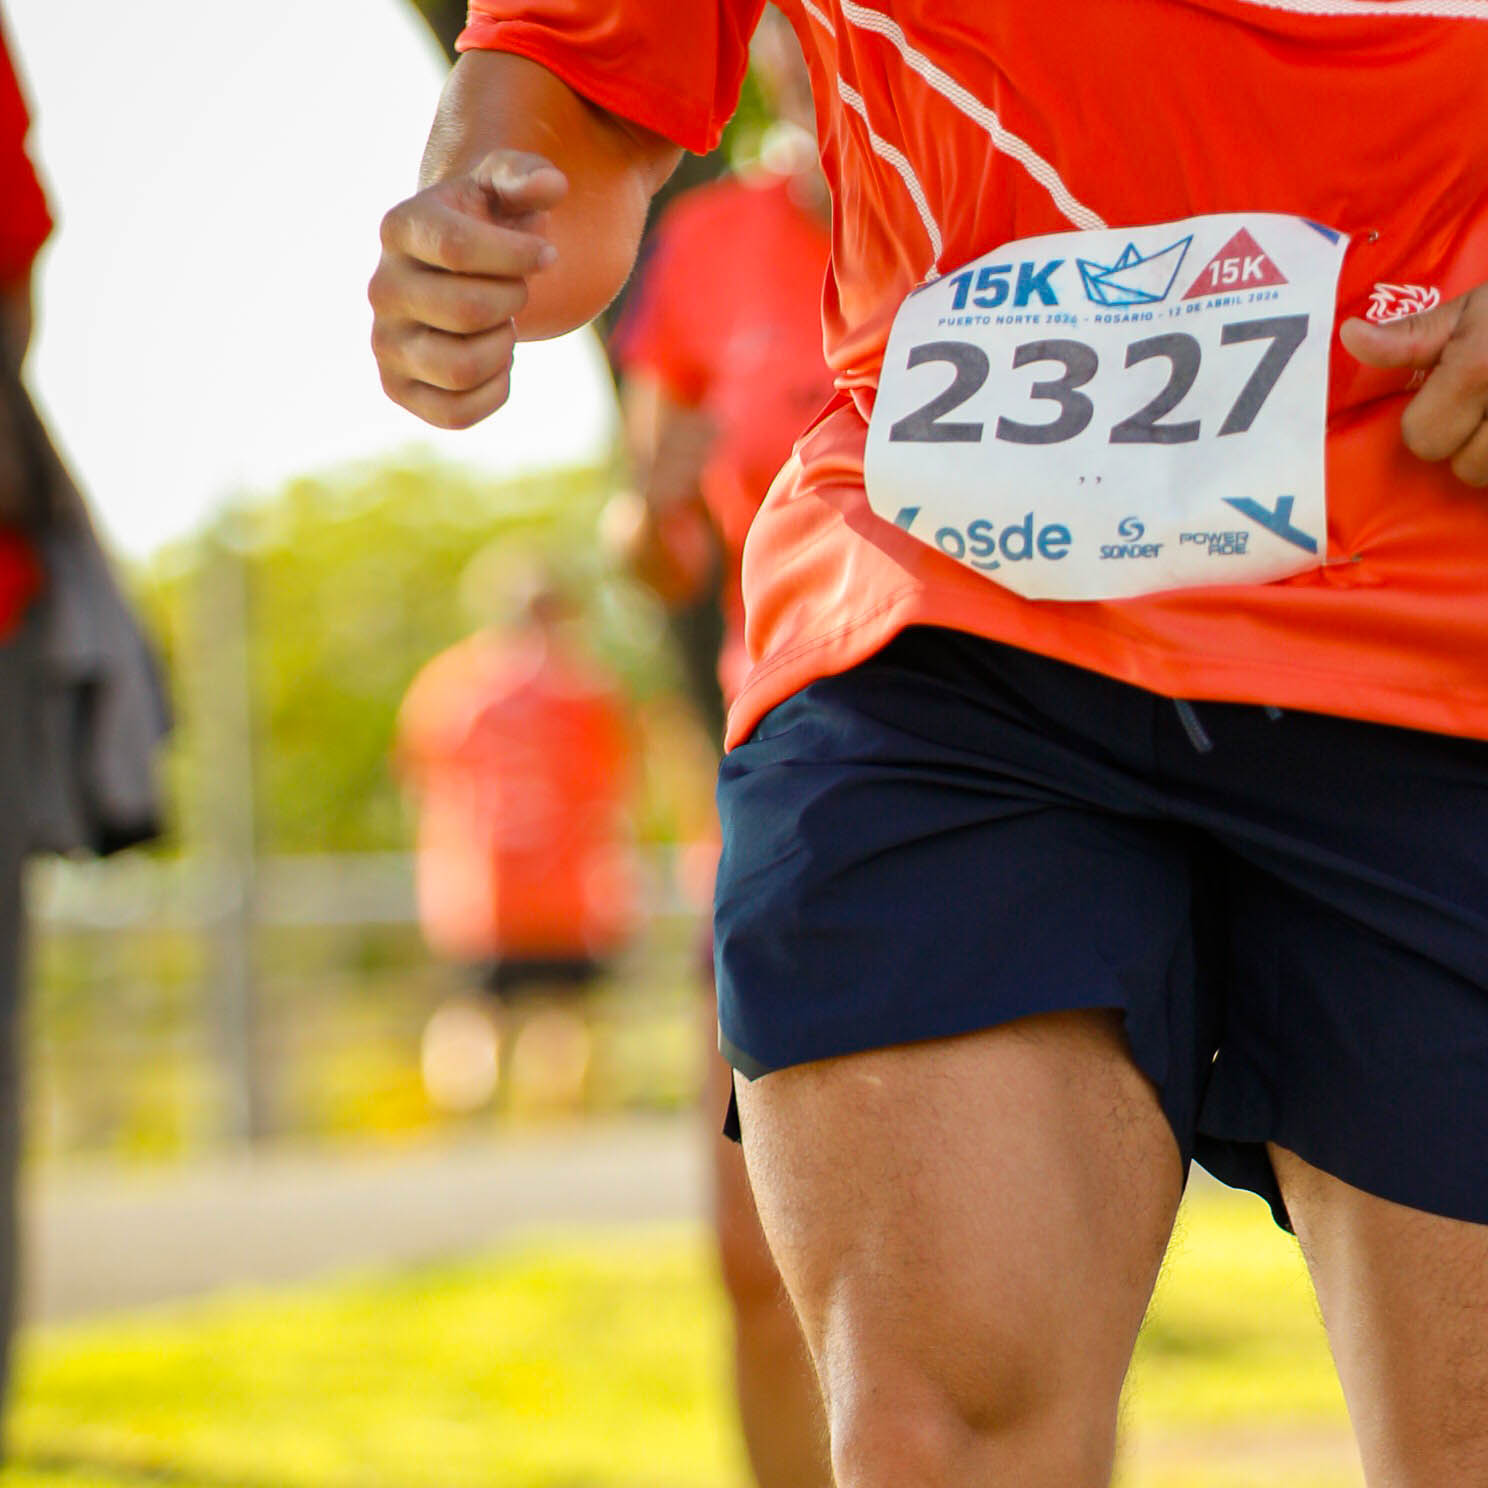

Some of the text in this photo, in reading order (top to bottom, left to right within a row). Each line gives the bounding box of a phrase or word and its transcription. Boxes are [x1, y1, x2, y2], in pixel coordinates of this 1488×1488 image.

[948, 258, 1067, 311] 15K
[1208, 254, 1265, 287] 15K
[938, 314, 991, 327] PUERTO
[995, 313, 1041, 325] NORTE
[1094, 312, 1153, 324] ROSARIO
[1186, 303, 1201, 314] DE
[1206, 297, 1243, 310] ABRIL
[888, 314, 1311, 446] 2327
[934, 512, 1072, 564] osde
